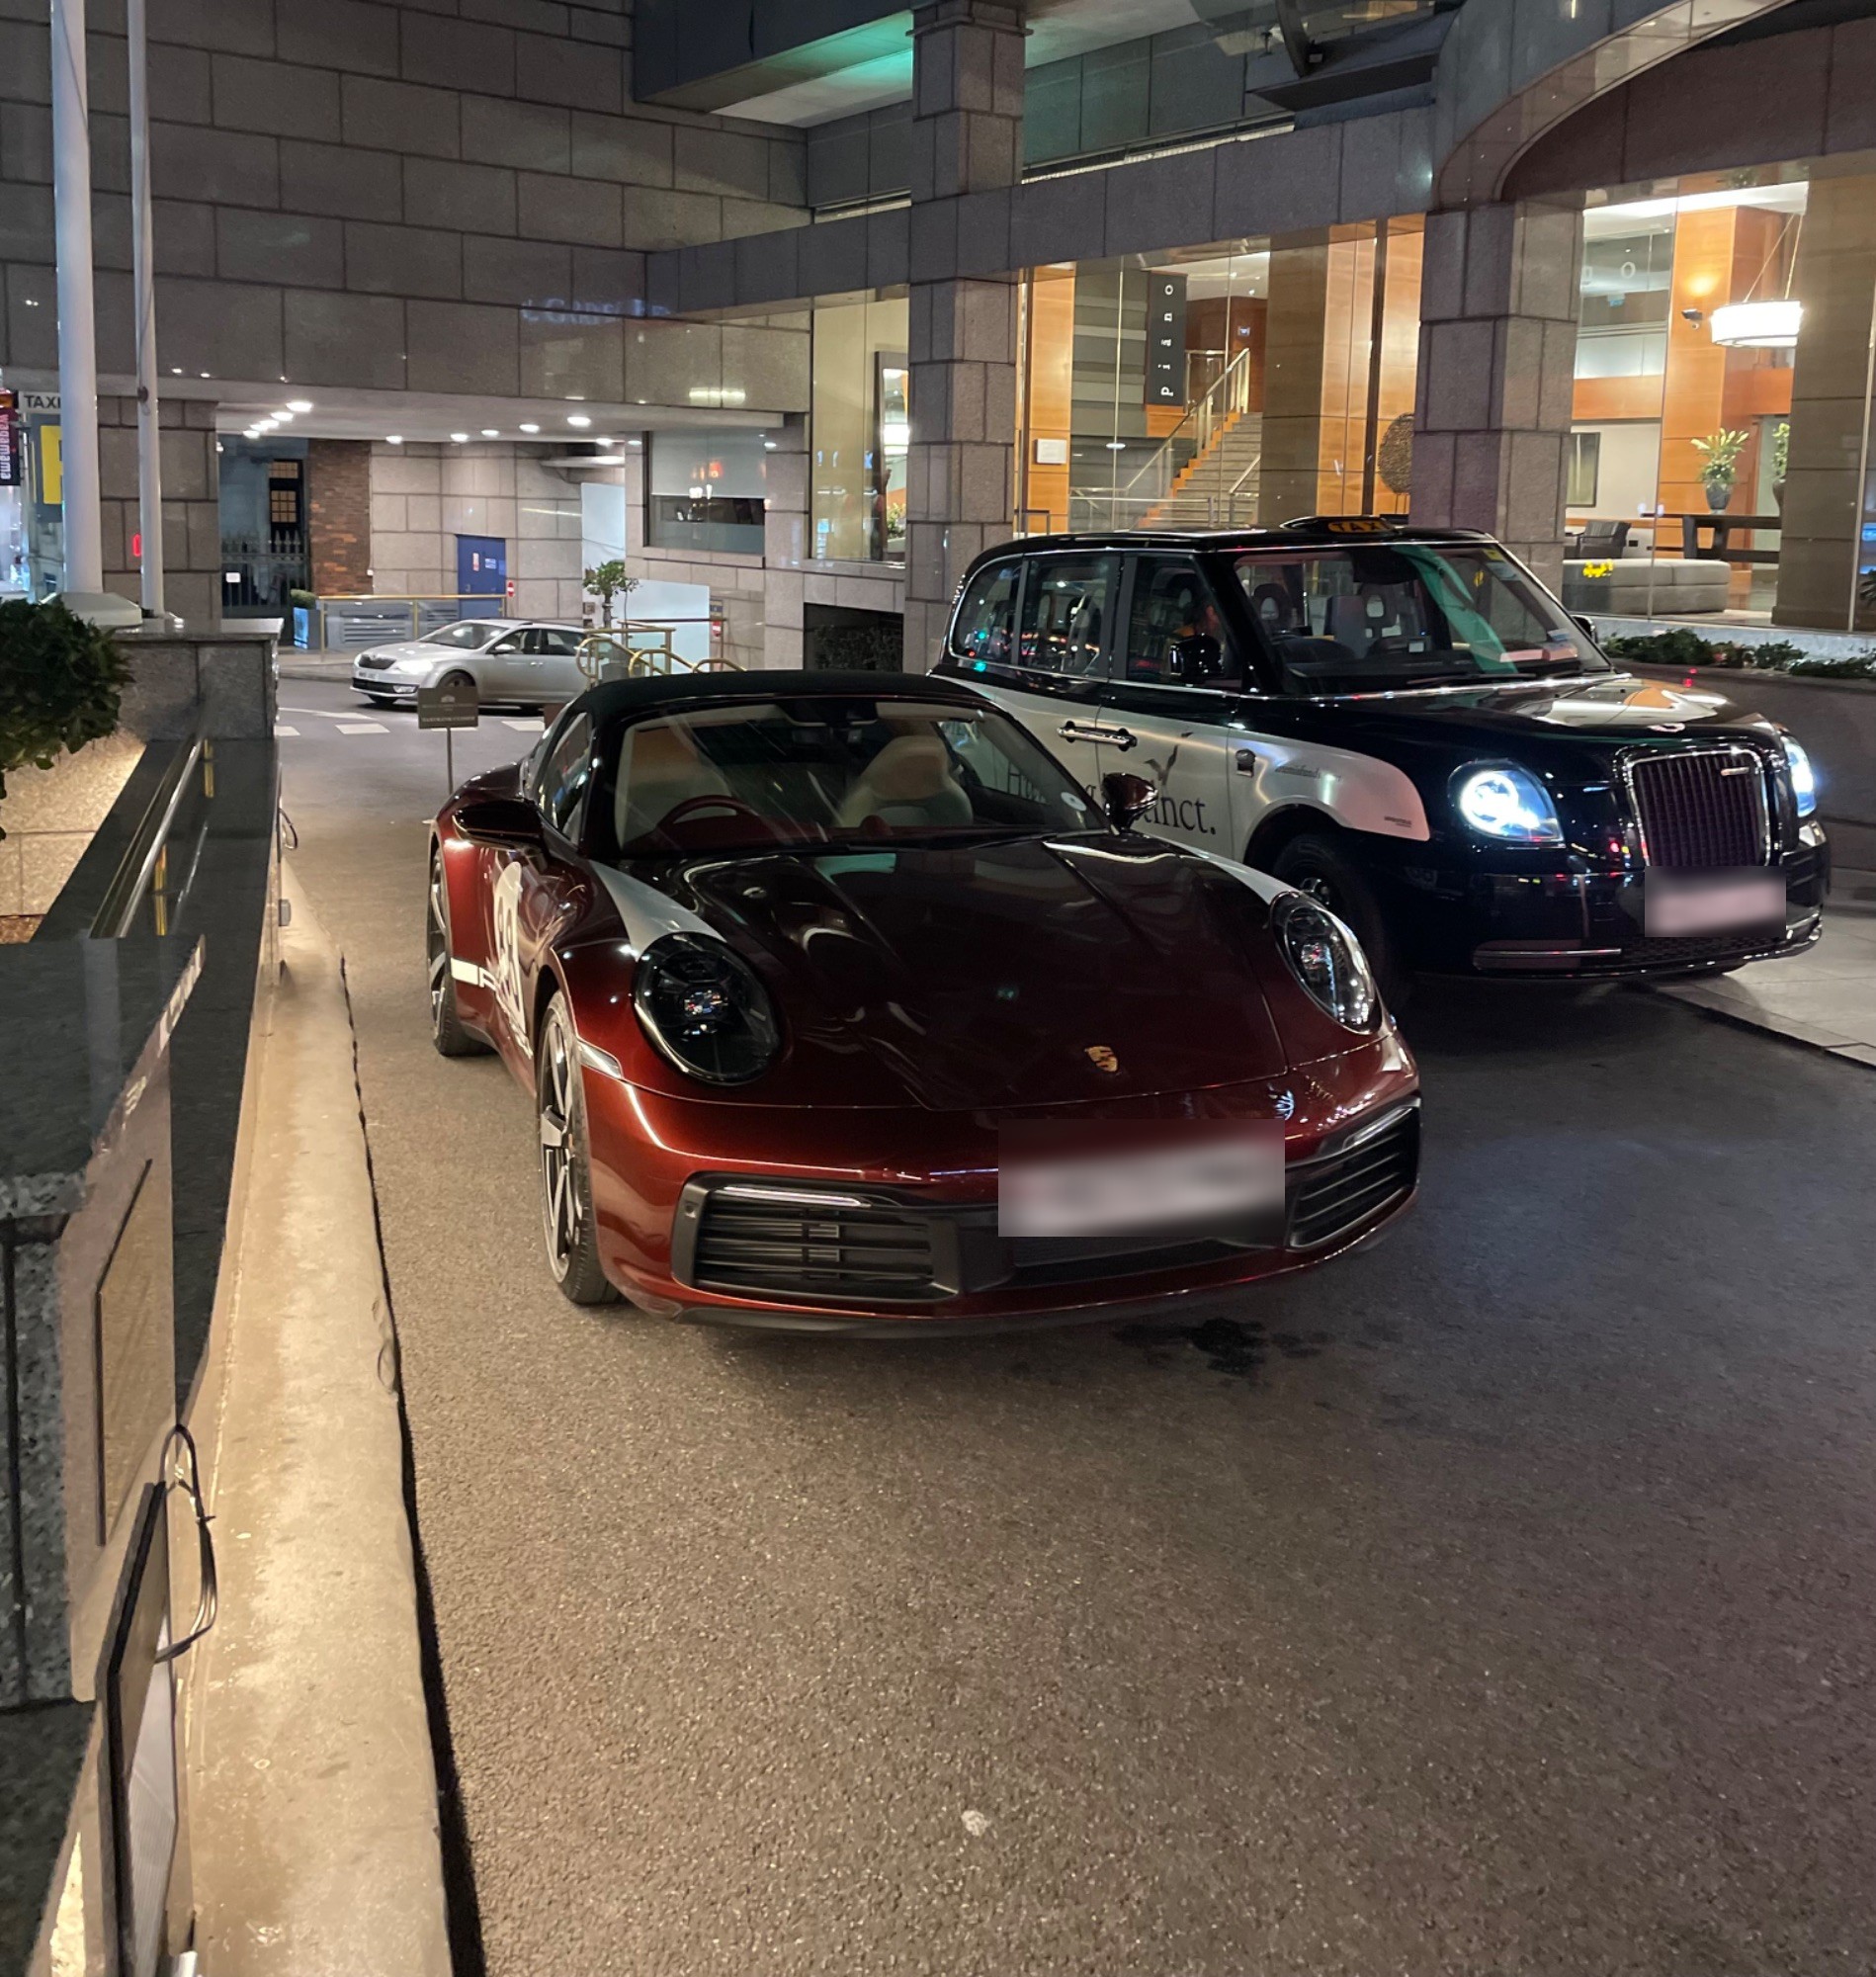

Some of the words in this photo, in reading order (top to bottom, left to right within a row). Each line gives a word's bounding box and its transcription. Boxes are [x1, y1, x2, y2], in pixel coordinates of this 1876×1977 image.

[24, 395, 61, 408] TAXI
[0, 414, 11, 479] wagamama
[1330, 521, 1390, 532] TAXI
